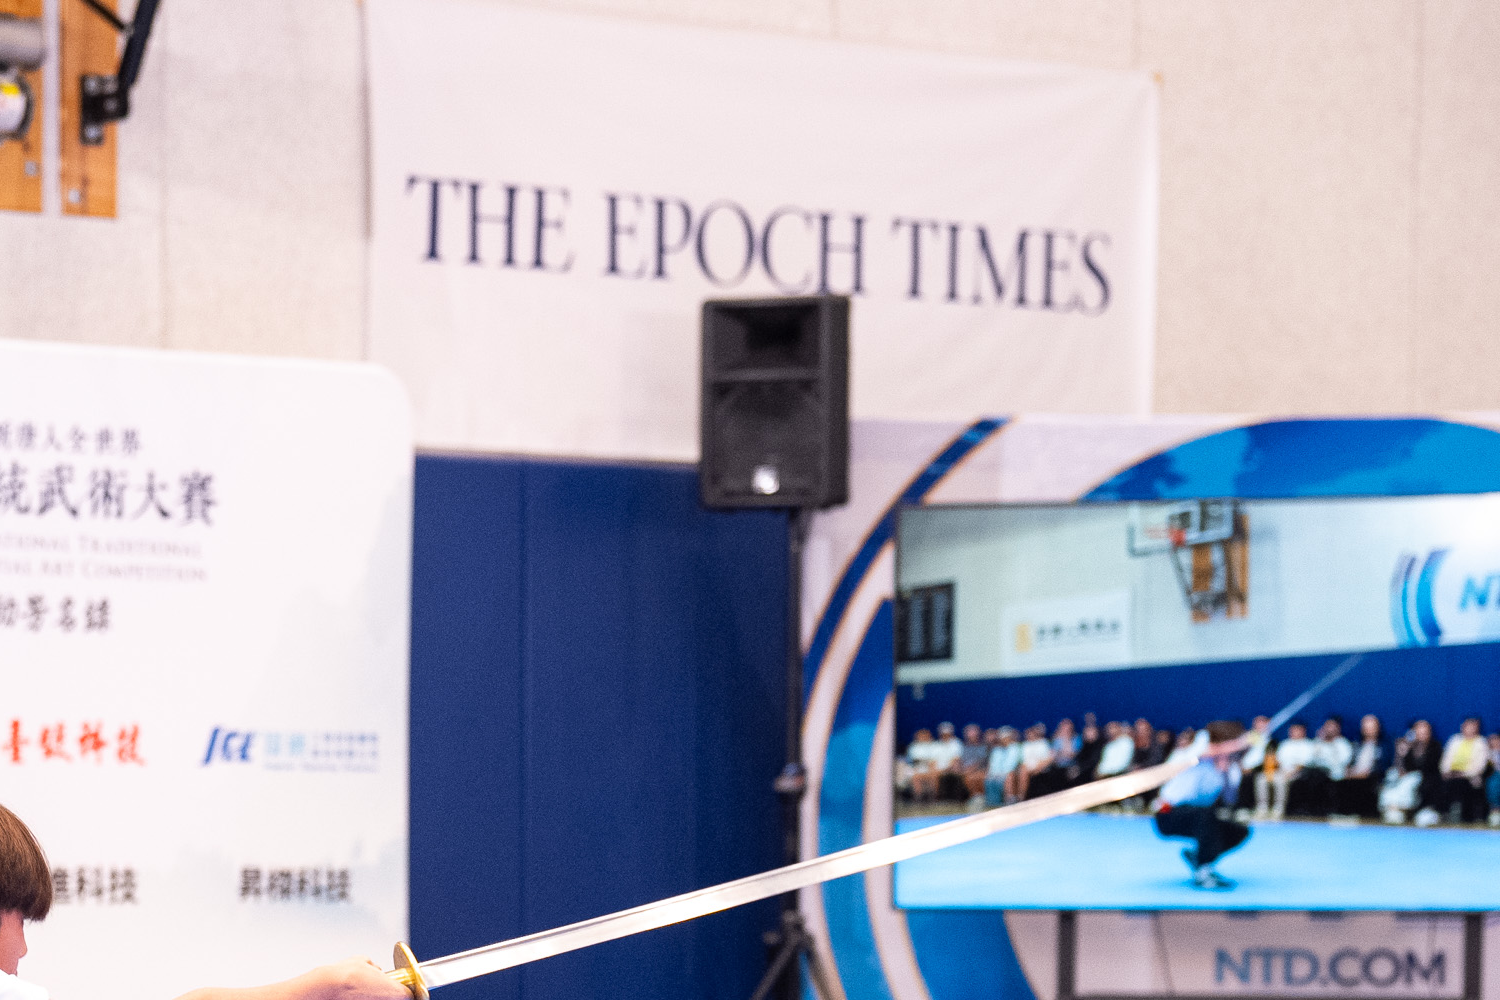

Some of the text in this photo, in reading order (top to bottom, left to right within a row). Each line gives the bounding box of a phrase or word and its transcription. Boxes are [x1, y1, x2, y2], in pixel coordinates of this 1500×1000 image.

[406, 174, 1114, 318] THE EPOCH TIMES
[1214, 946, 1447, 989] NTD.COM
